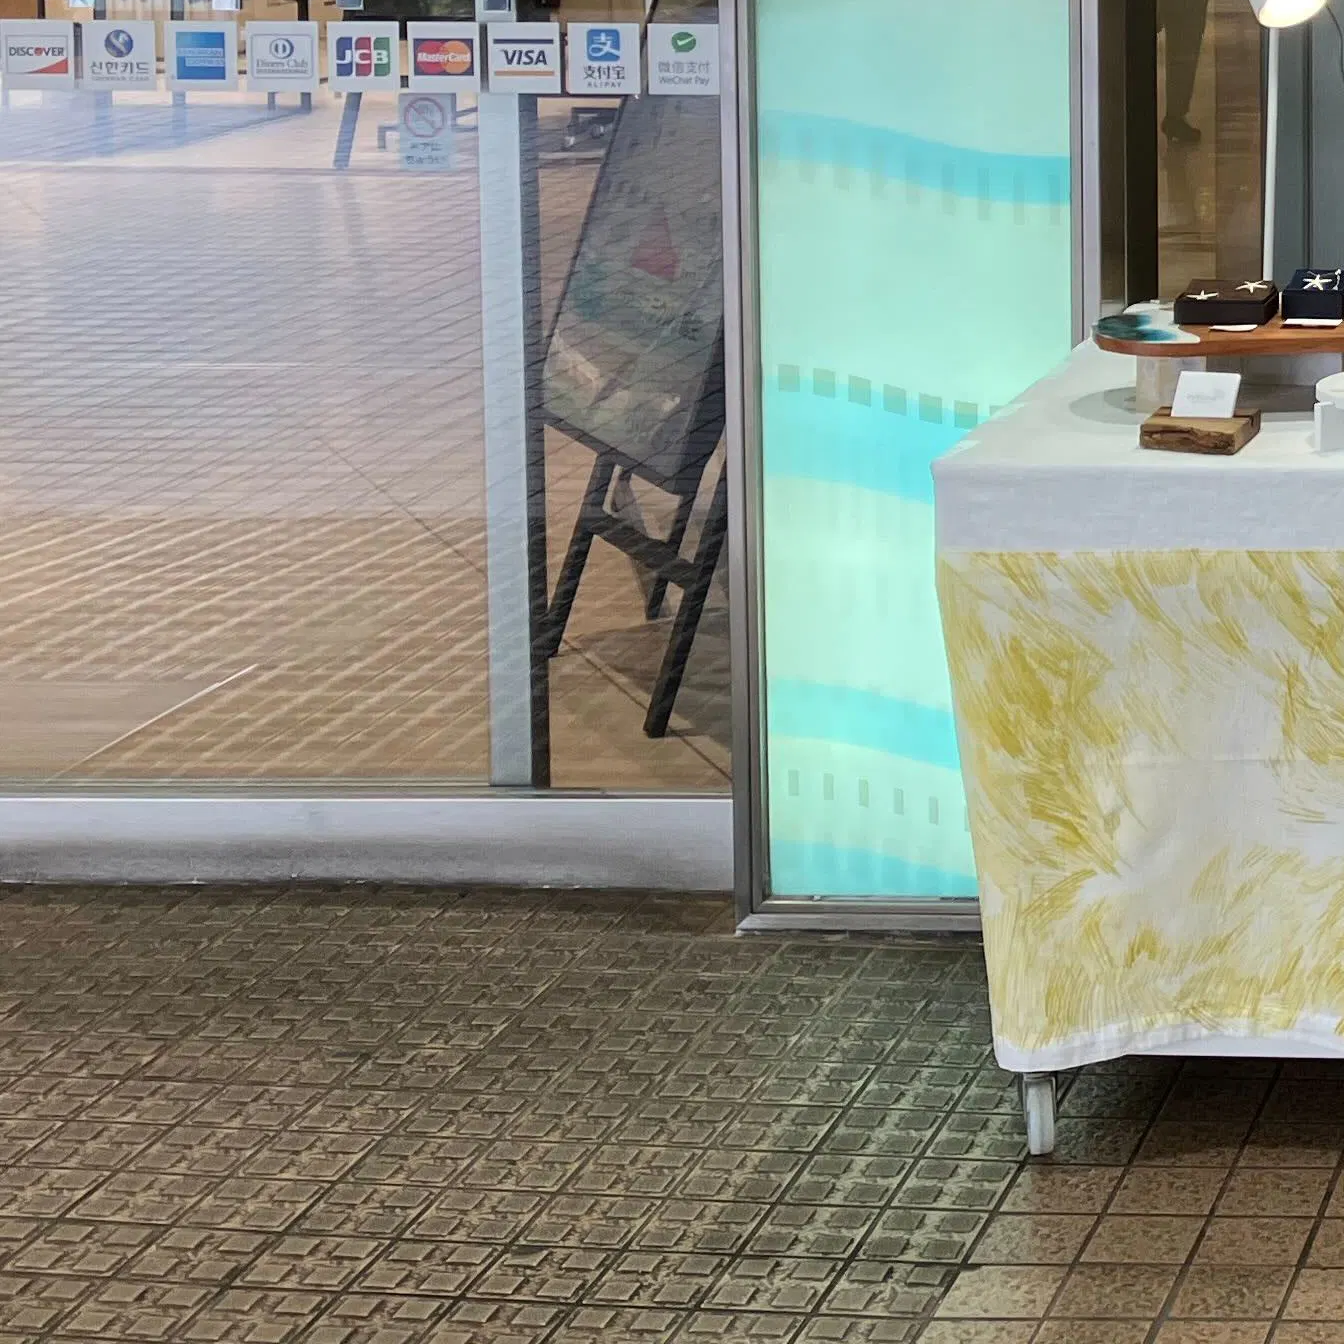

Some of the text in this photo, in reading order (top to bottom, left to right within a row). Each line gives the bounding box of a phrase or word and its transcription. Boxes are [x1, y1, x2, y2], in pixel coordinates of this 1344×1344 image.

[9, 46, 65, 57] DISCOVER
[336, 49, 389, 64] JCB
[416, 52, 471, 62] MasterCard
[287, 58, 308, 68] Club
[503, 49, 548, 66] VISA
[583, 65, 625, 80] 支付宝
[658, 76, 710, 86] WeChat Pay
